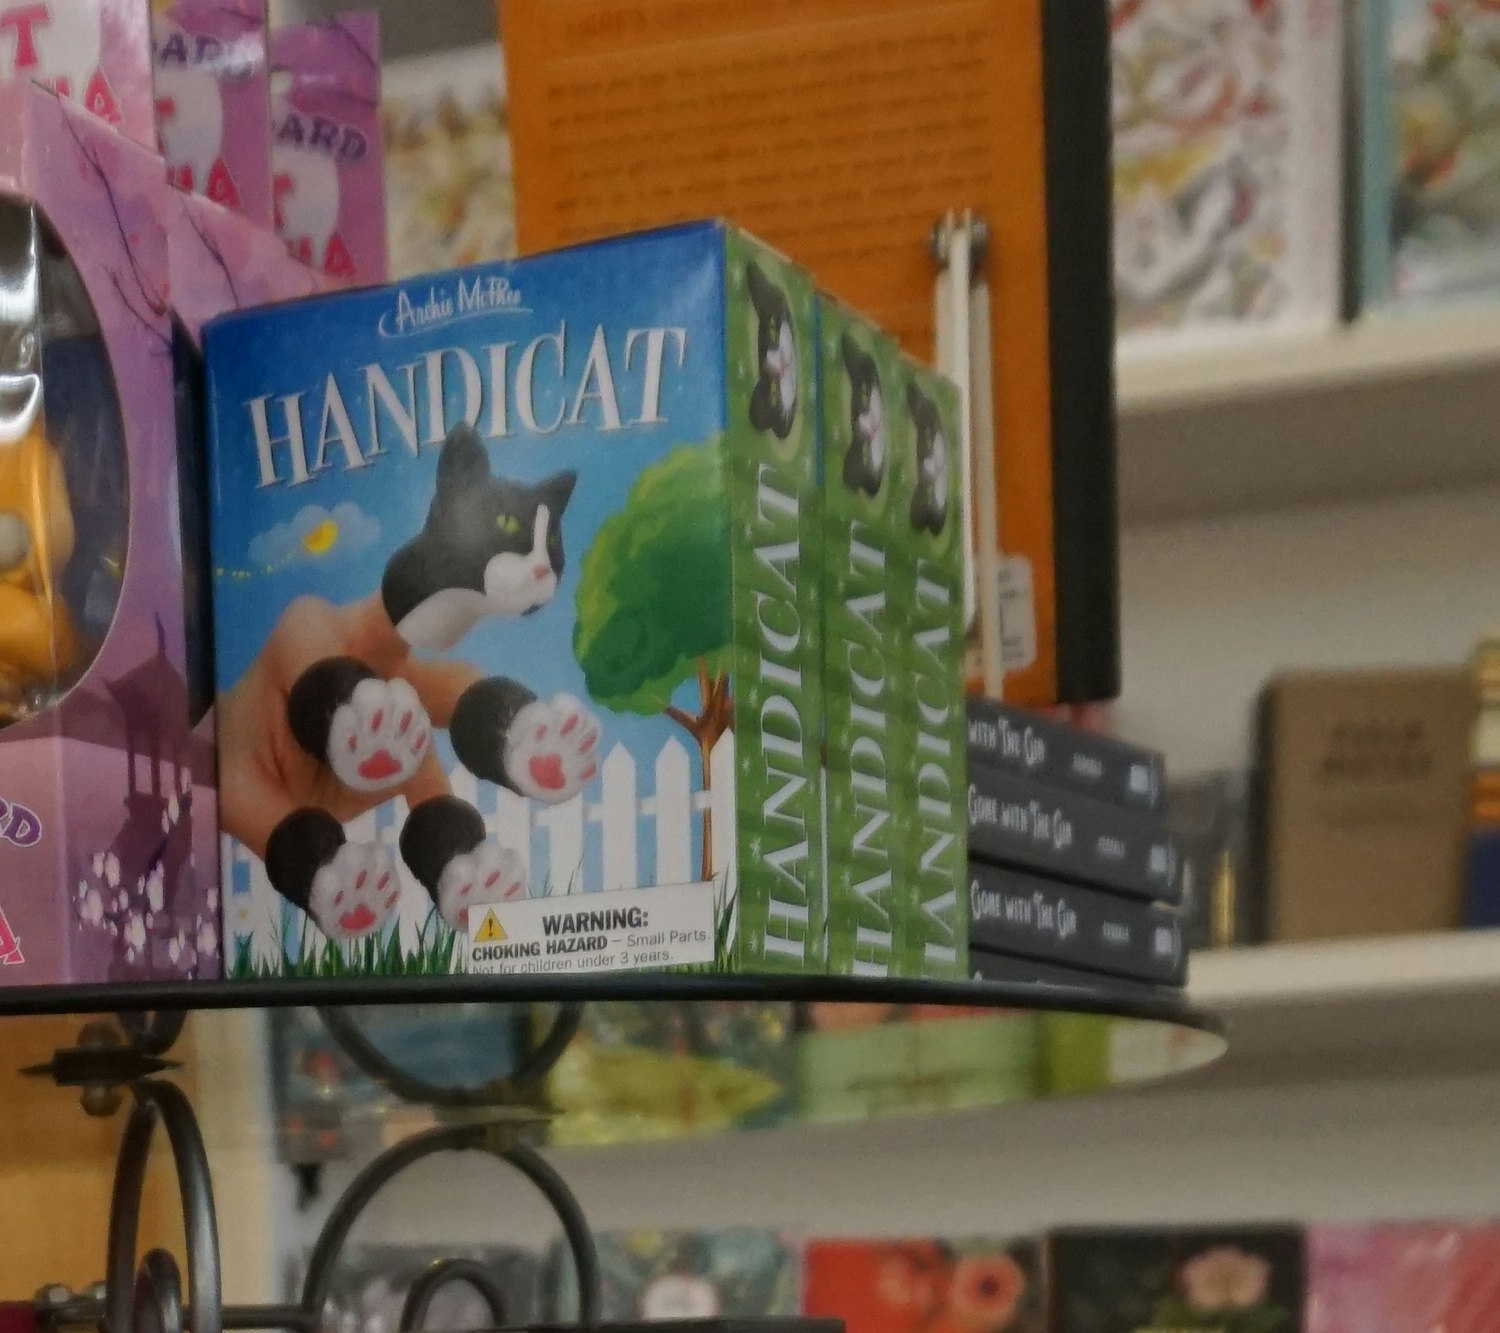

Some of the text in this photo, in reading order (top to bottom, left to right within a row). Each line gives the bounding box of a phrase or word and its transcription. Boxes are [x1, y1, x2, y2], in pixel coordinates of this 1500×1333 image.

[251, 322, 688, 489] HANDICAT
[542, 906, 649, 937] WARNING:
[472, 928, 711, 962] CHOKING HAZARD Small Parts.
[520, 958, 572, 974] children
[577, 955, 615, 971] under
[620, 952, 629, 965] 3
[633, 949, 674, 968] years.
